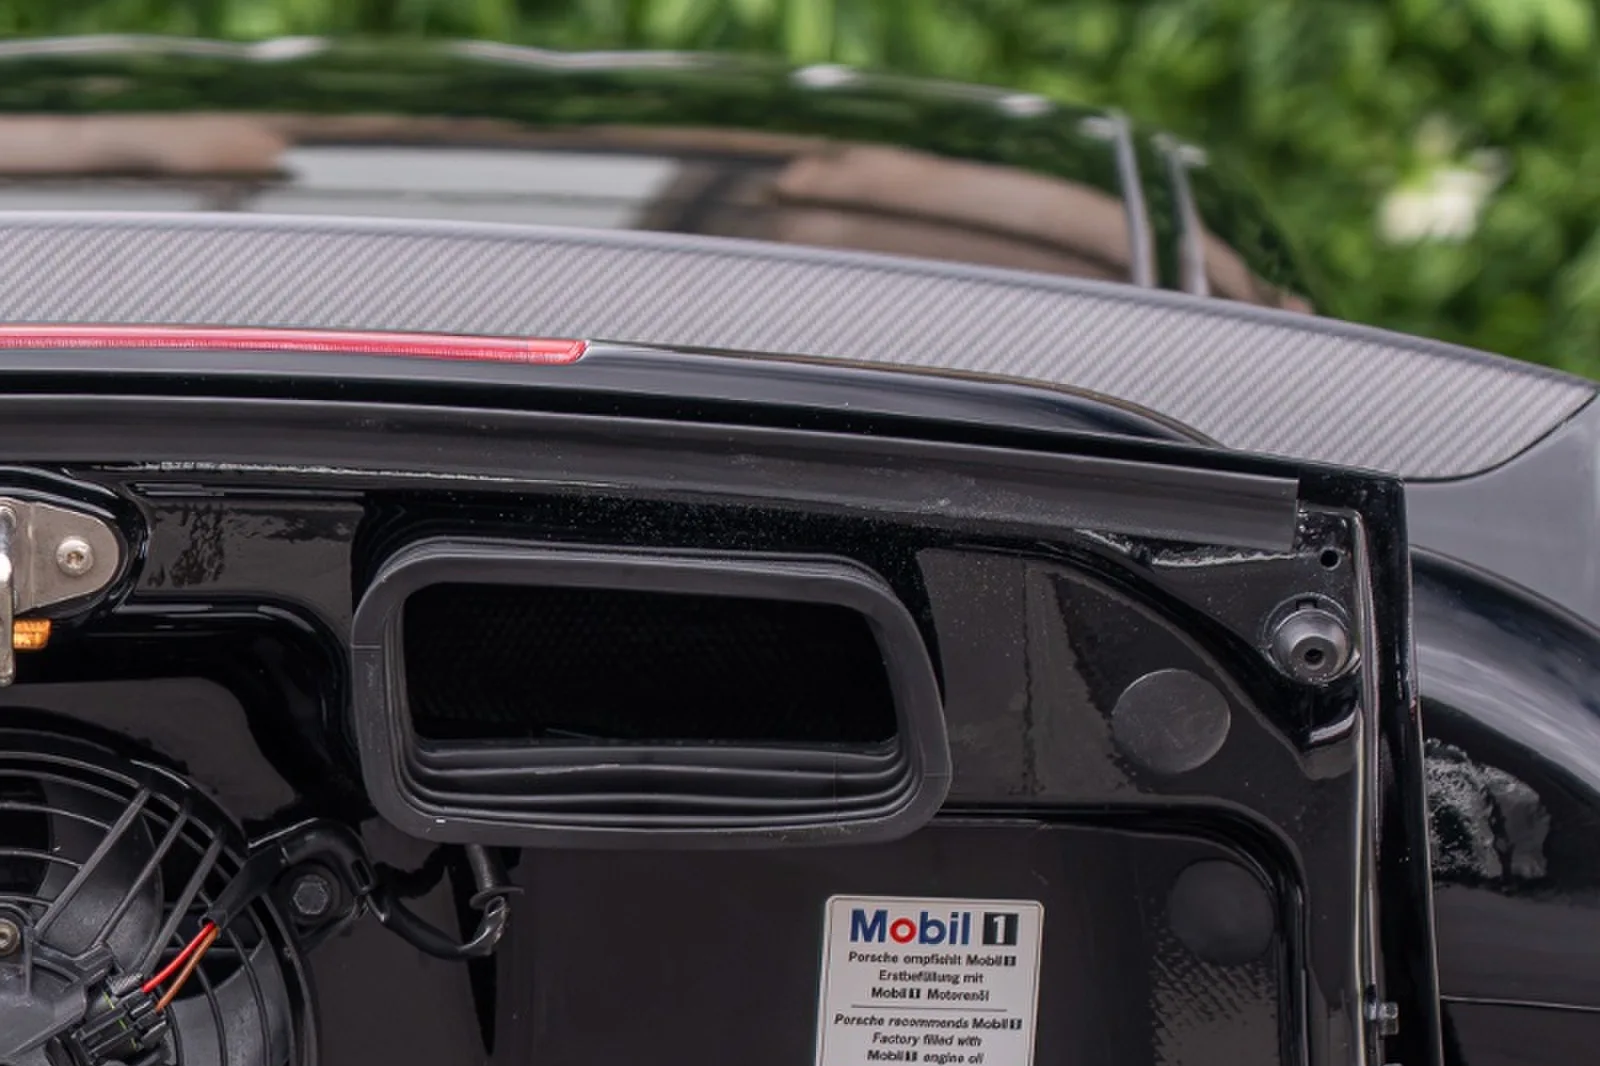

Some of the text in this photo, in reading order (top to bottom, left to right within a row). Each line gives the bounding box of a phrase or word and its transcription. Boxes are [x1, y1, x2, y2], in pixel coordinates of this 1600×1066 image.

[850, 908, 970, 945] Mobil
[848, 951, 898, 964] Porsche
[963, 973, 984, 984] mit
[927, 988, 990, 1001] Motorenöl
[833, 1013, 885, 1027] Porsche
[888, 1016, 969, 1029] recommends
[872, 1032, 982, 1047] Factory filled with
[923, 1053, 964, 1066] engine
[967, 1052, 984, 1065] oil
